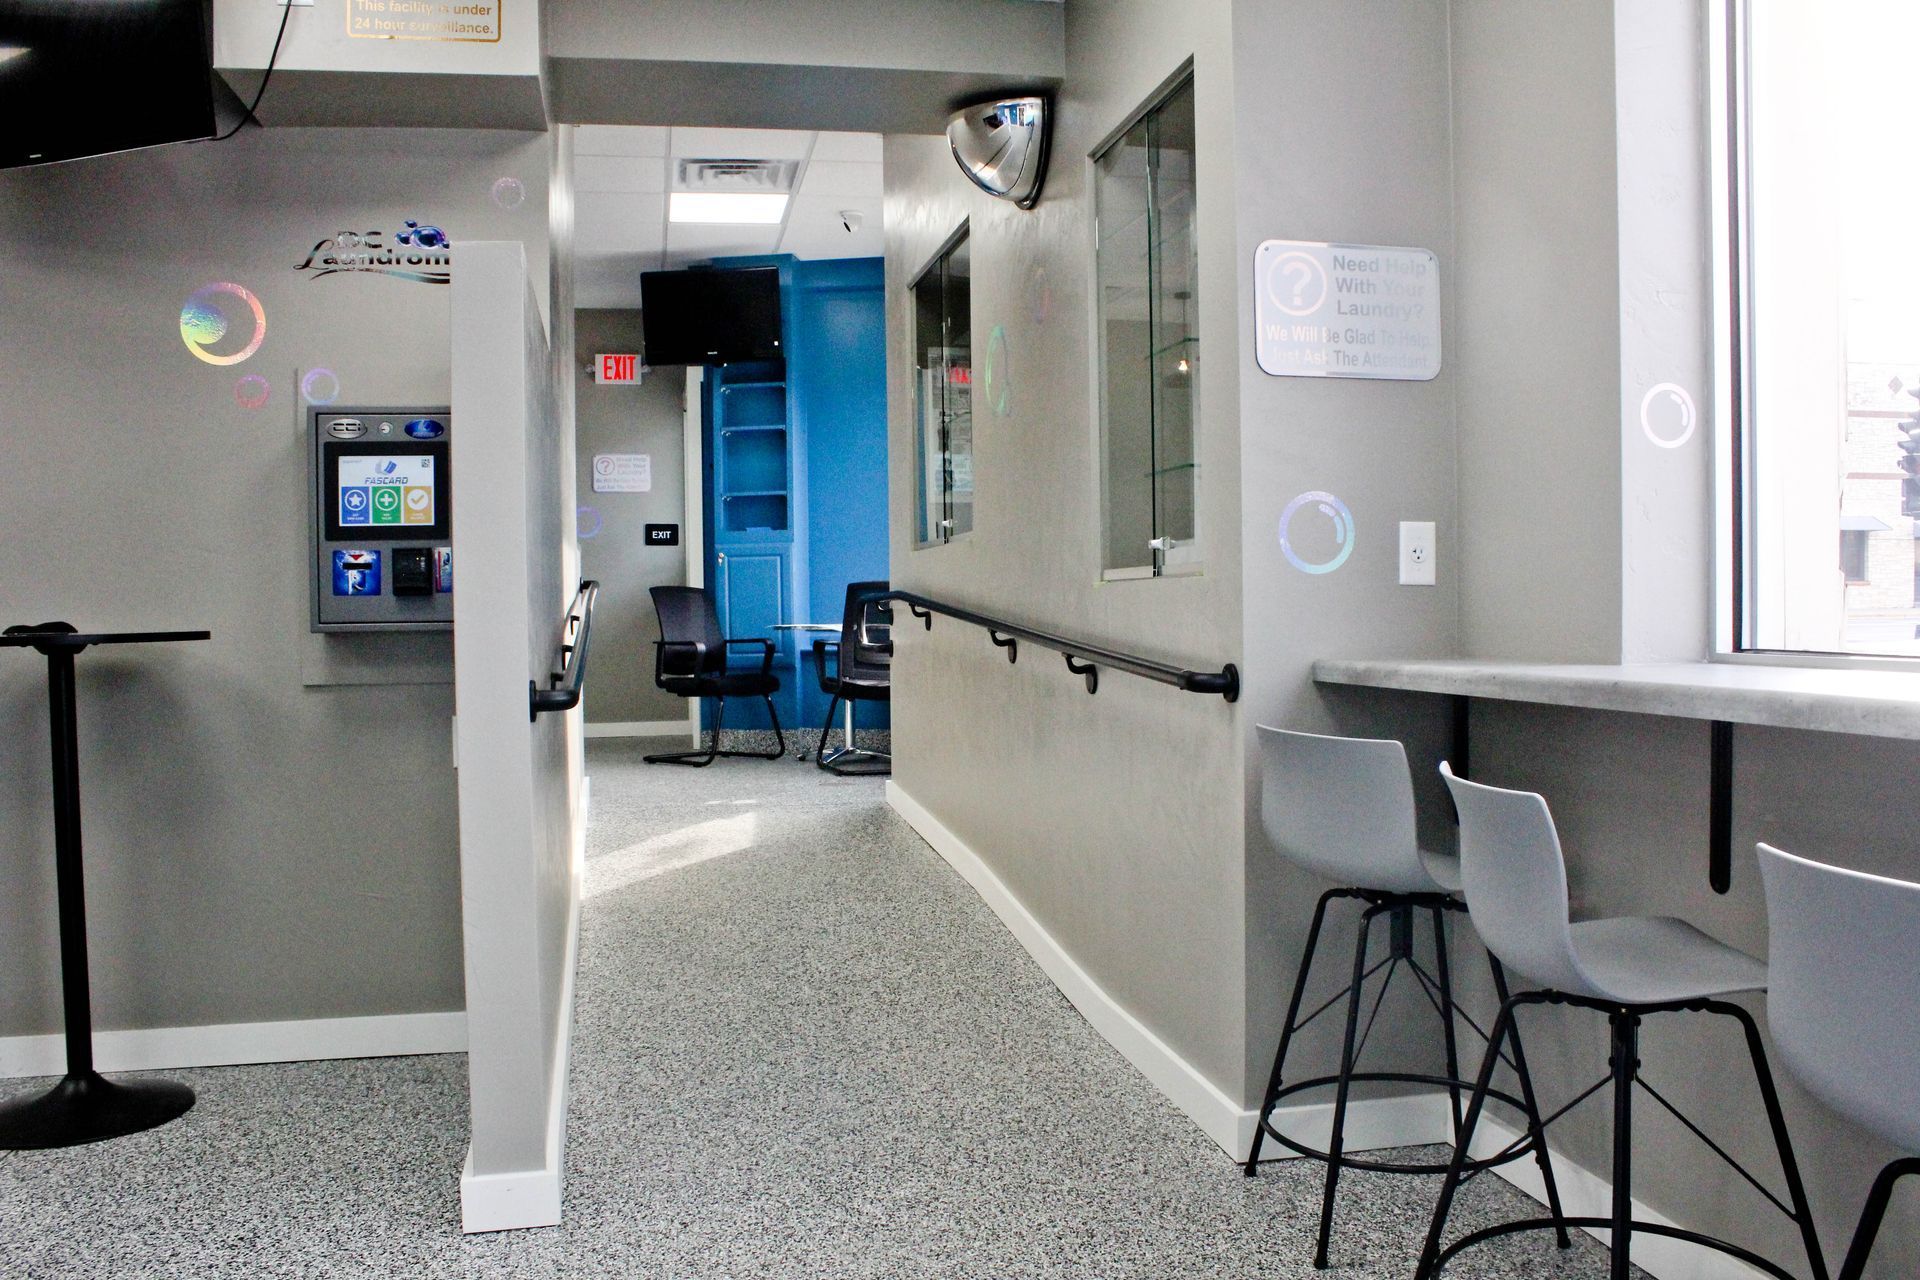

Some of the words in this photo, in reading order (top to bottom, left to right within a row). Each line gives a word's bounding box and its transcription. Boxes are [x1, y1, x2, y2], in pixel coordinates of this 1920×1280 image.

[357, 0, 385, 11] This
[389, 1, 433, 16] facility
[438, 5, 449, 13] is
[453, 5, 493, 15] under
[354, 17, 371, 29] 24
[374, 18, 406, 31] hour
[409, 22, 494, 34] surveillance.
[337, 230, 383, 249] DC
[293, 239, 450, 271] Laundrom
[1333, 255, 1379, 272] Need
[1386, 259, 1427, 279] Help
[1336, 277, 1377, 295] With
[1382, 280, 1425, 297] Your
[1337, 300, 1425, 321] Laundry?
[1266, 324, 1289, 342] We
[1292, 325, 1318, 343] Will
[1323, 326, 1340, 344] Be
[1344, 328, 1376, 346] Glad
[1380, 331, 1395, 345] To
[1272, 349, 1301, 363] Just
[1304, 350, 1328, 365] Ask
[1333, 350, 1359, 366] The
[603, 355, 636, 380] EXIT
[364, 476, 409, 485] FASCARD
[652, 530, 672, 539] EXIT
